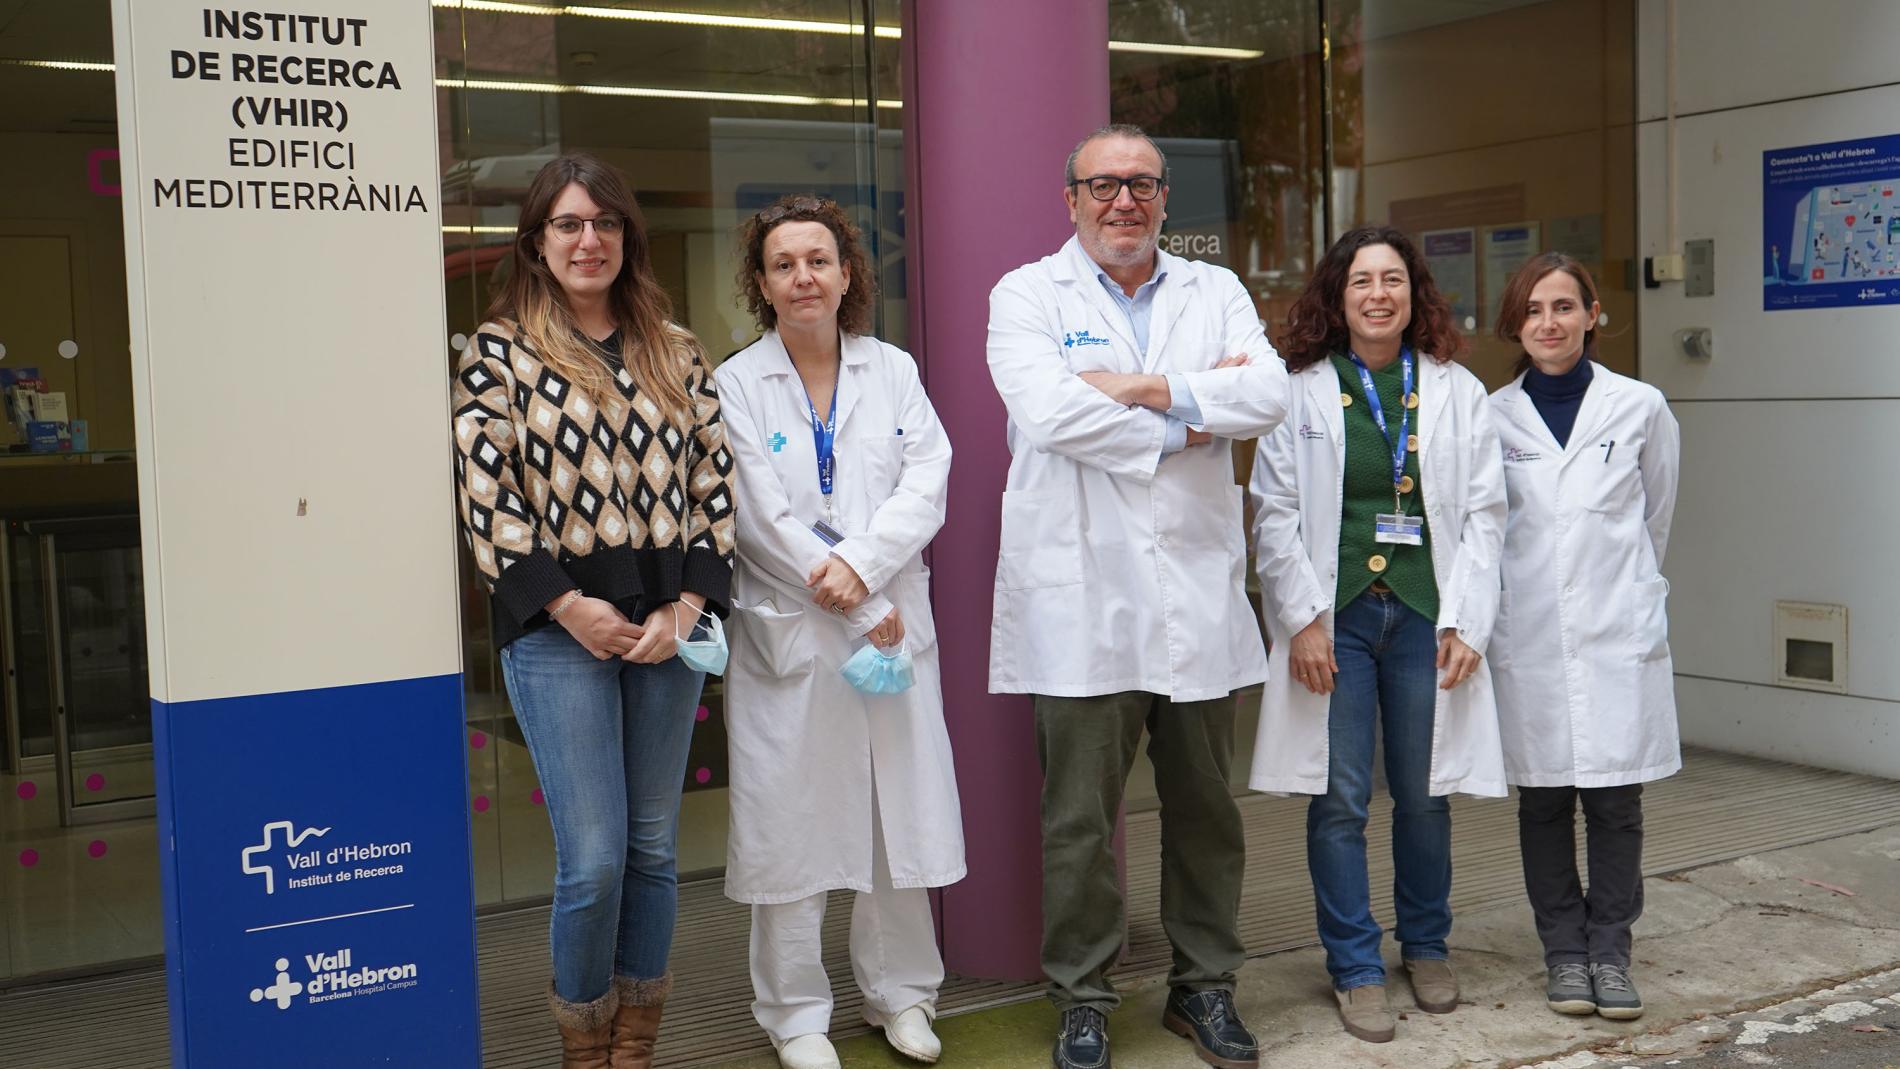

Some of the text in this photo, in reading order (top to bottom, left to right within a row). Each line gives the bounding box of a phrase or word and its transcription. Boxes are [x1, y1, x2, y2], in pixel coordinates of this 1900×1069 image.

[203, 8, 367, 47] INSTITUT
[171, 50, 402, 90] DE RECERCA
[232, 95, 348, 133] (VHIR)
[229, 137, 354, 170] EDIFICI
[1821, 150, 1837, 161] Vall
[1838, 148, 1875, 158] d'Hebron
[154, 175, 428, 213] MEDITERRÀNIA
[286, 841, 412, 870] Vall d'Hebron
[288, 864, 404, 889] Institut de Recerca
[305, 948, 351, 973] Vall
[307, 963, 417, 995] d'Hebron
[309, 979, 418, 1004] Barcelona Hospital Campus
